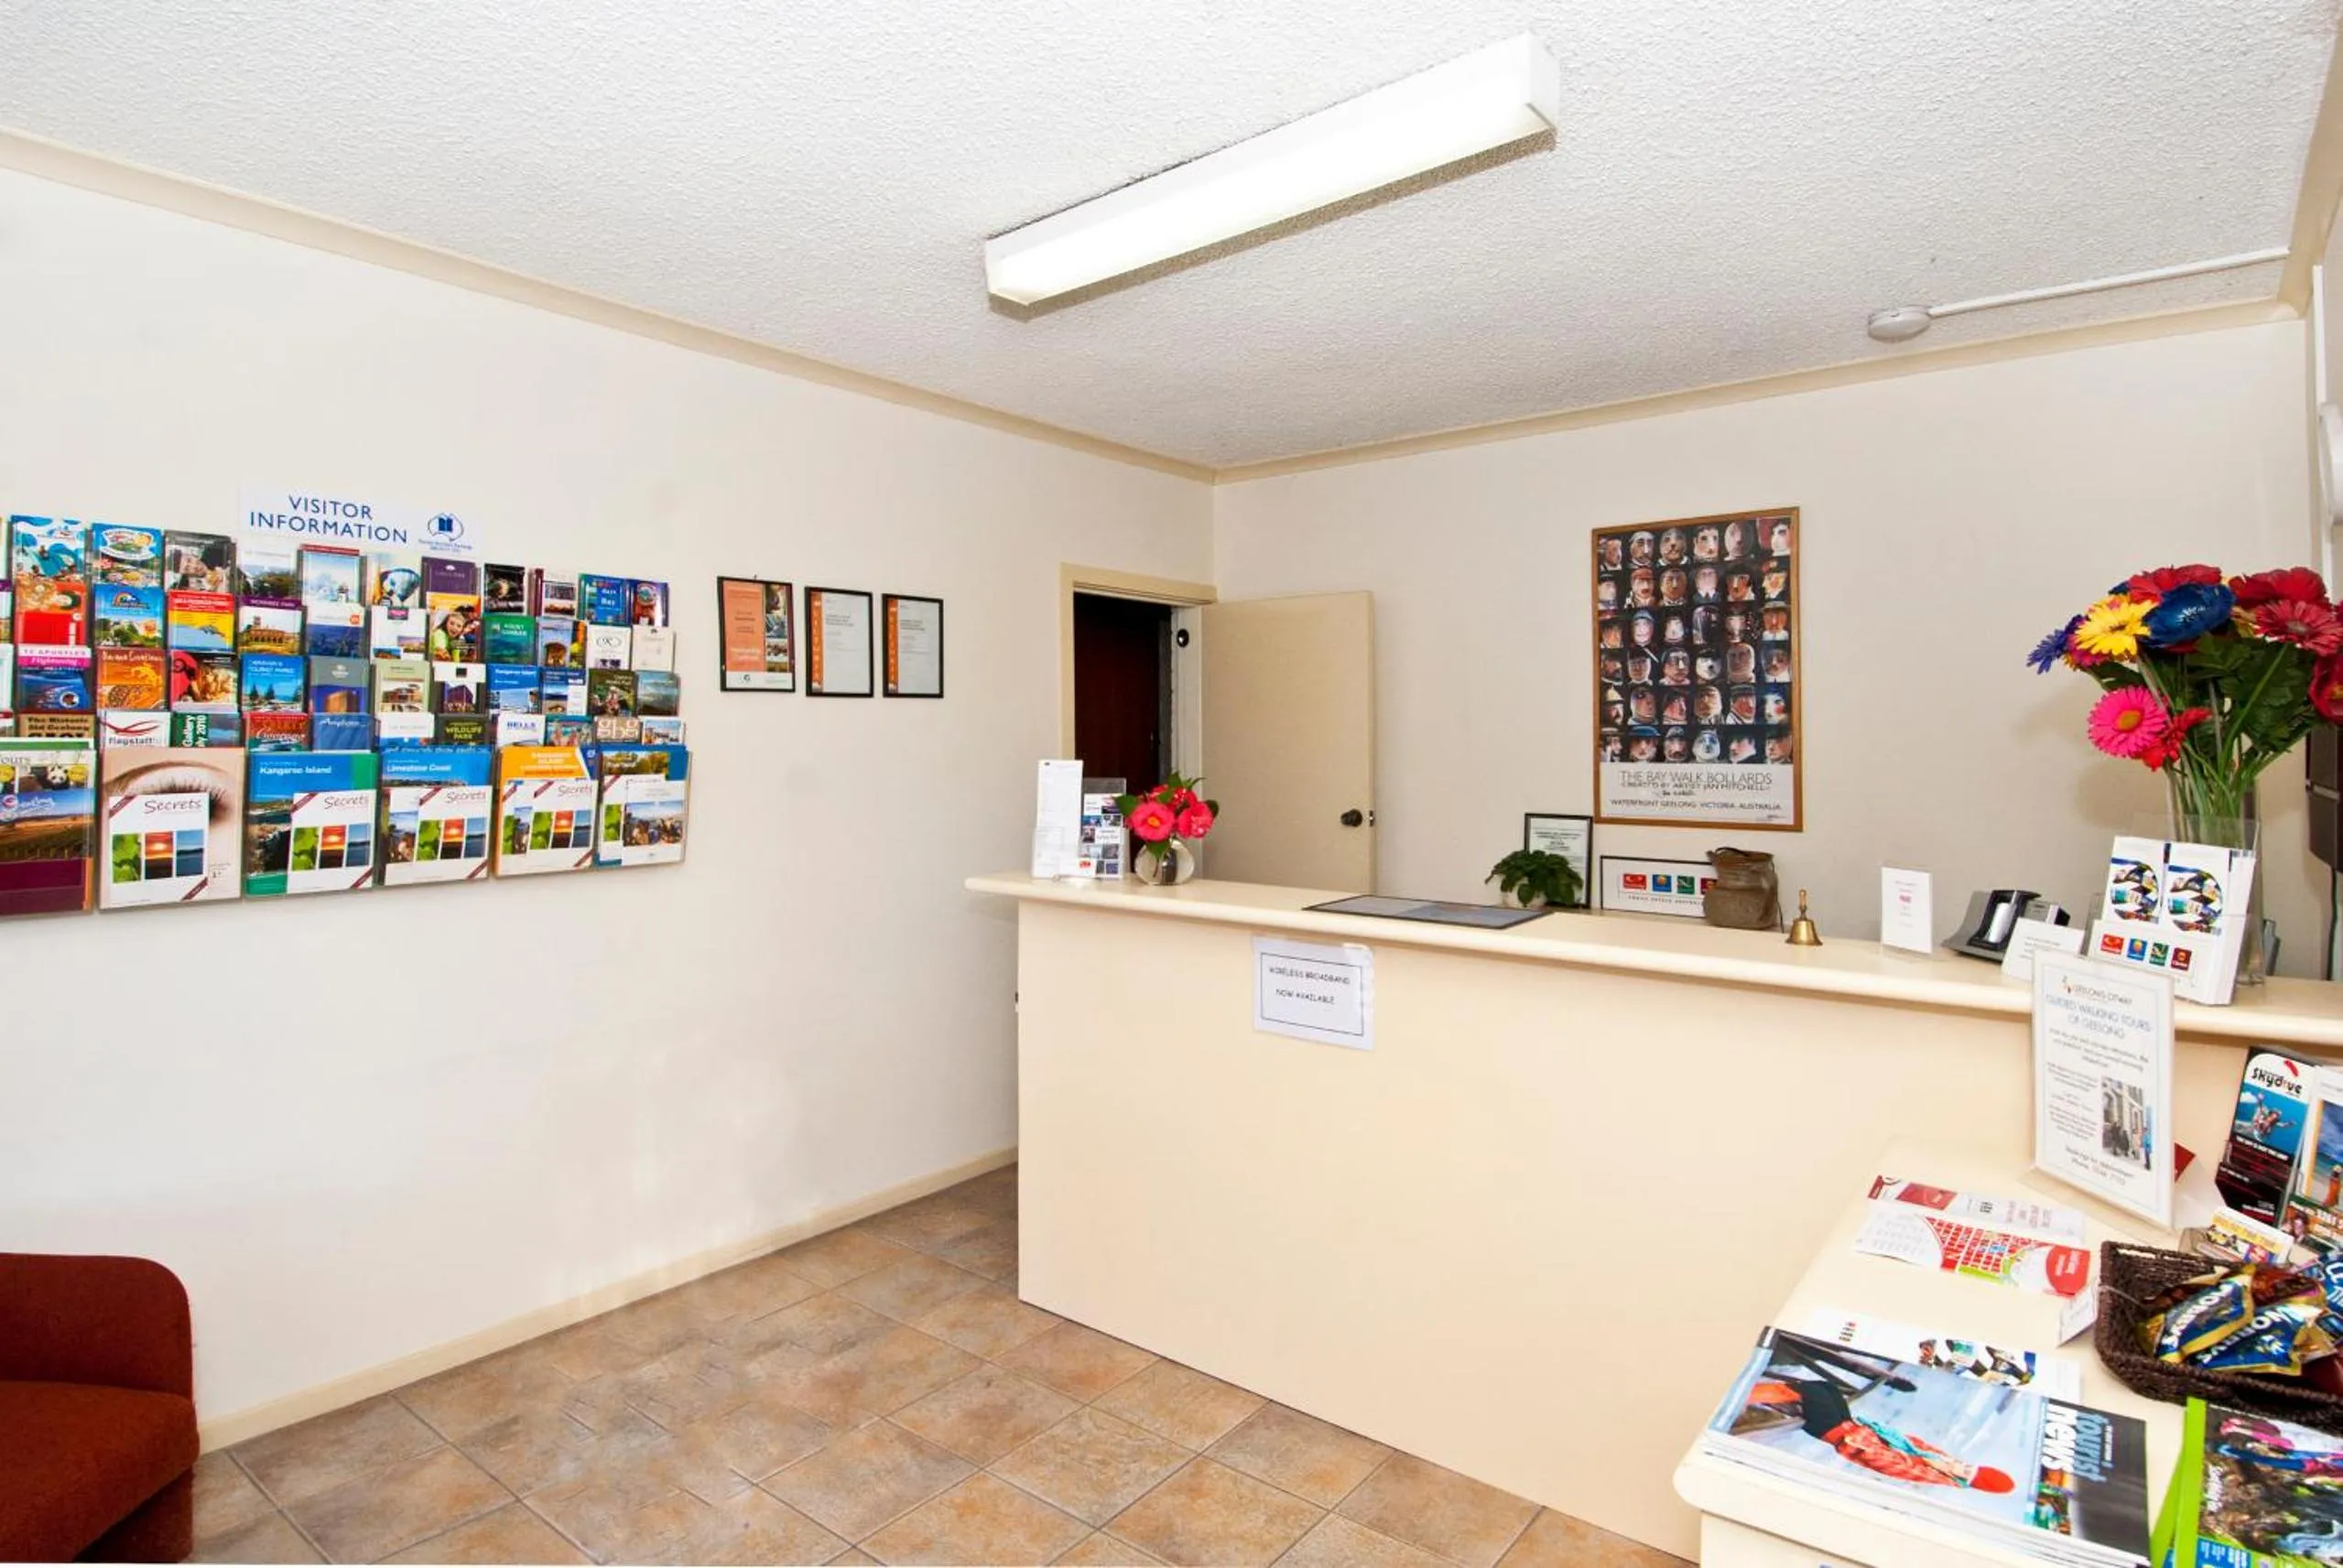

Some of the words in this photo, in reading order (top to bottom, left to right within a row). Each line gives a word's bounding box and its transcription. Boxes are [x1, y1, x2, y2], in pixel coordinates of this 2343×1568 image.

[288, 494, 374, 520] VISITOR
[250, 511, 408, 544] INFORMATION
[108, 737, 153, 746] flagstaff
[259, 766, 303, 775] Kangaroo
[306, 765, 331, 774] Island
[1620, 771, 1643, 782] THE
[1646, 771, 1668, 783] BAY
[1669, 772, 1702, 784] WALK
[1707, 771, 1773, 784] BOLLARDS
[143, 798, 202, 814] Secrets
[323, 793, 370, 809] Secrets
[1611, 799, 1659, 807] WATERFRONT
[1269, 967, 1304, 979] WIRELESS
[1305, 971, 1350, 985] BROADBAND
[1275, 989, 1294, 998] NOW
[1296, 992, 1335, 1004] AVAILABLE
[2077, 1001, 2119, 1023] WALKING
[2121, 1013, 2152, 1033] TOURS
[2041, 1402, 2077, 1474] news
